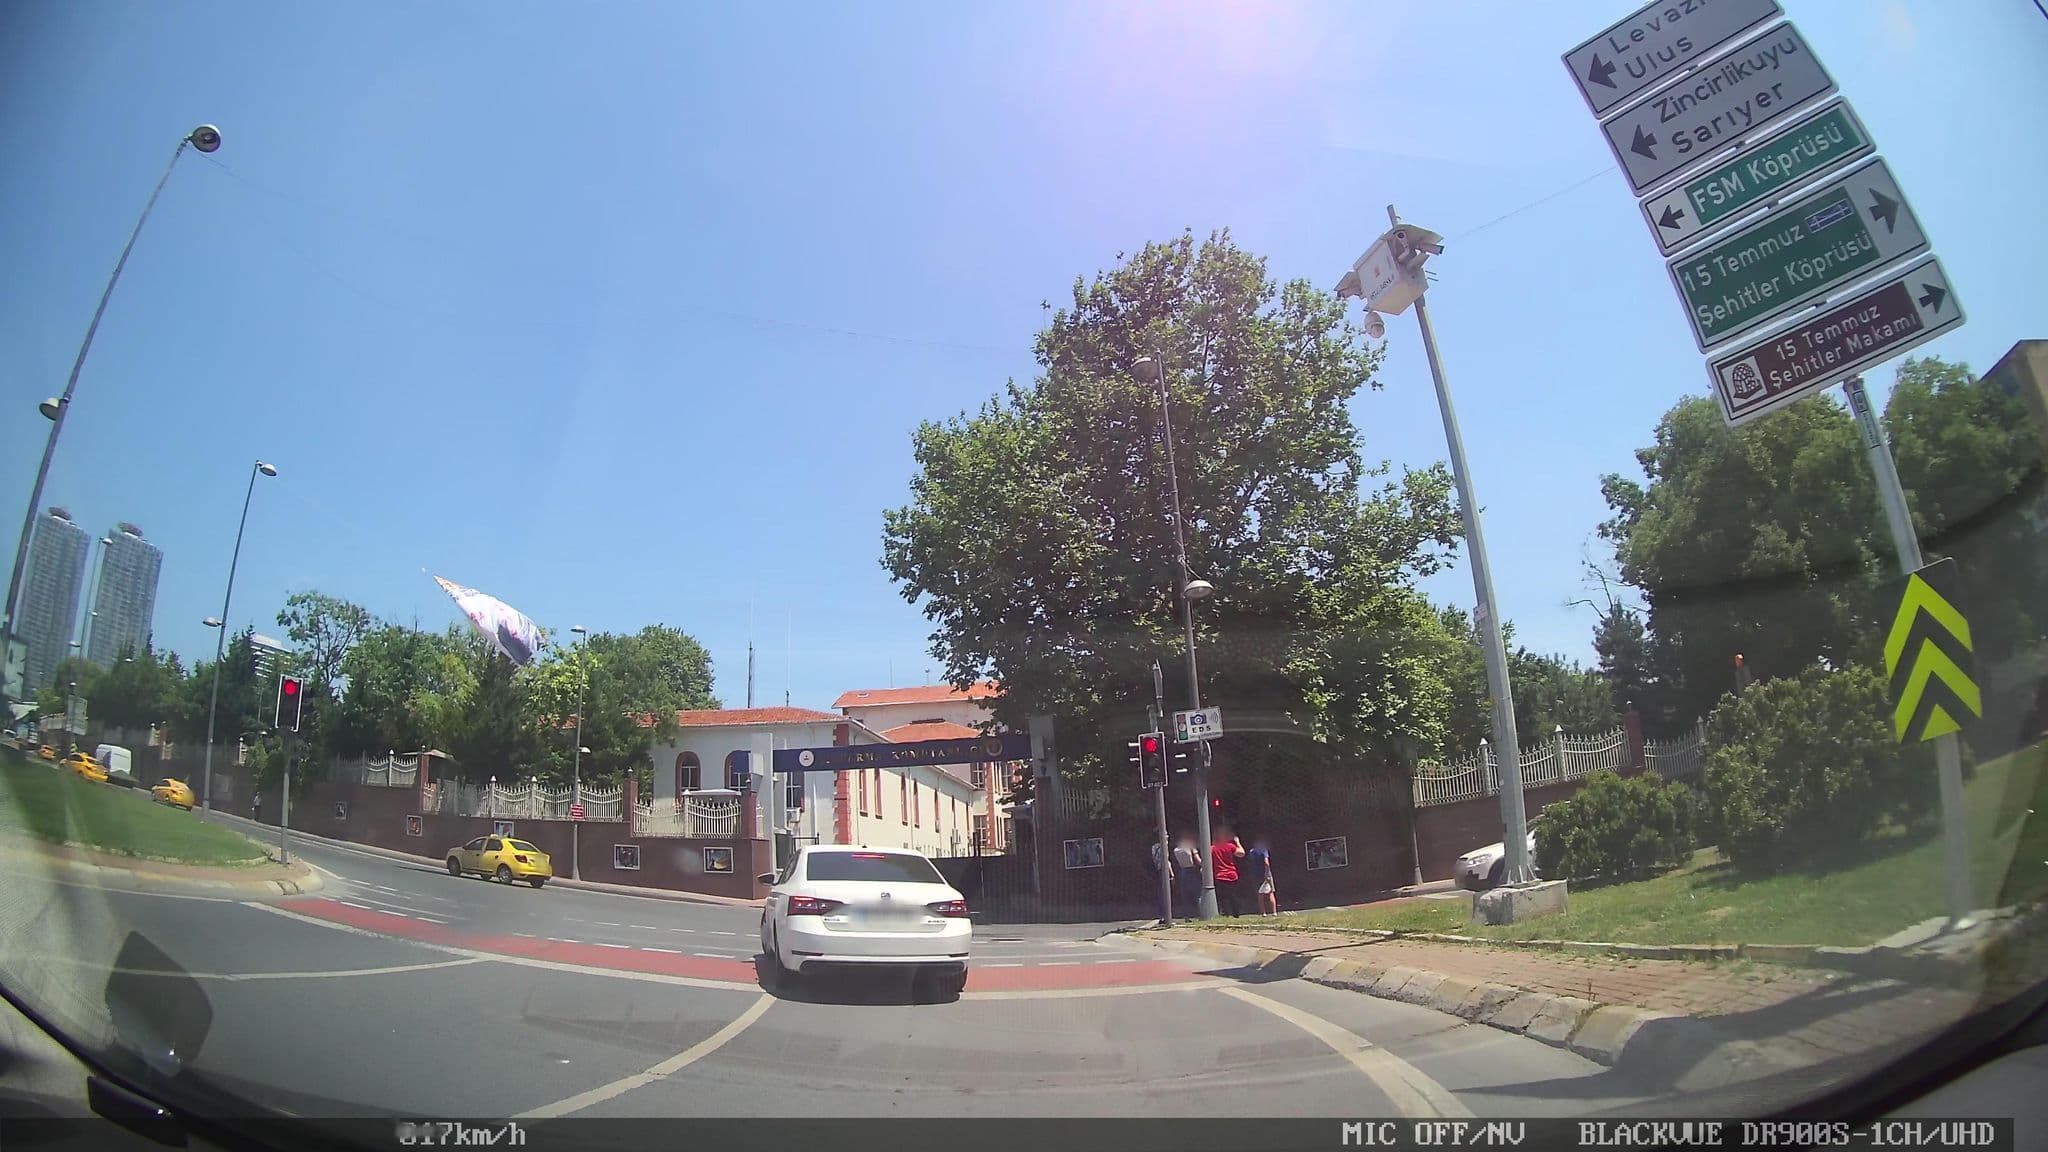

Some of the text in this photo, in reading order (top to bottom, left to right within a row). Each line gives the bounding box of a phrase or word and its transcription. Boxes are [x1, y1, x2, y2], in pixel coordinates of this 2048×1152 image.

[1609, 0, 1706, 54] Levaz
[1624, 36, 1693, 79] Ulus
[1652, 34, 1798, 124] Zincirlikuyu
[1671, 82, 1783, 154] Sarıyer
[1692, 121, 1844, 213] FSM Köprüsü
[1684, 224, 1805, 292] 15 Temmuz
[1698, 230, 1873, 328] Şehitler Köprüsü
[1769, 313, 1916, 389] Şehitler Makamı
[1776, 305, 1880, 360] 15 Temmuz
